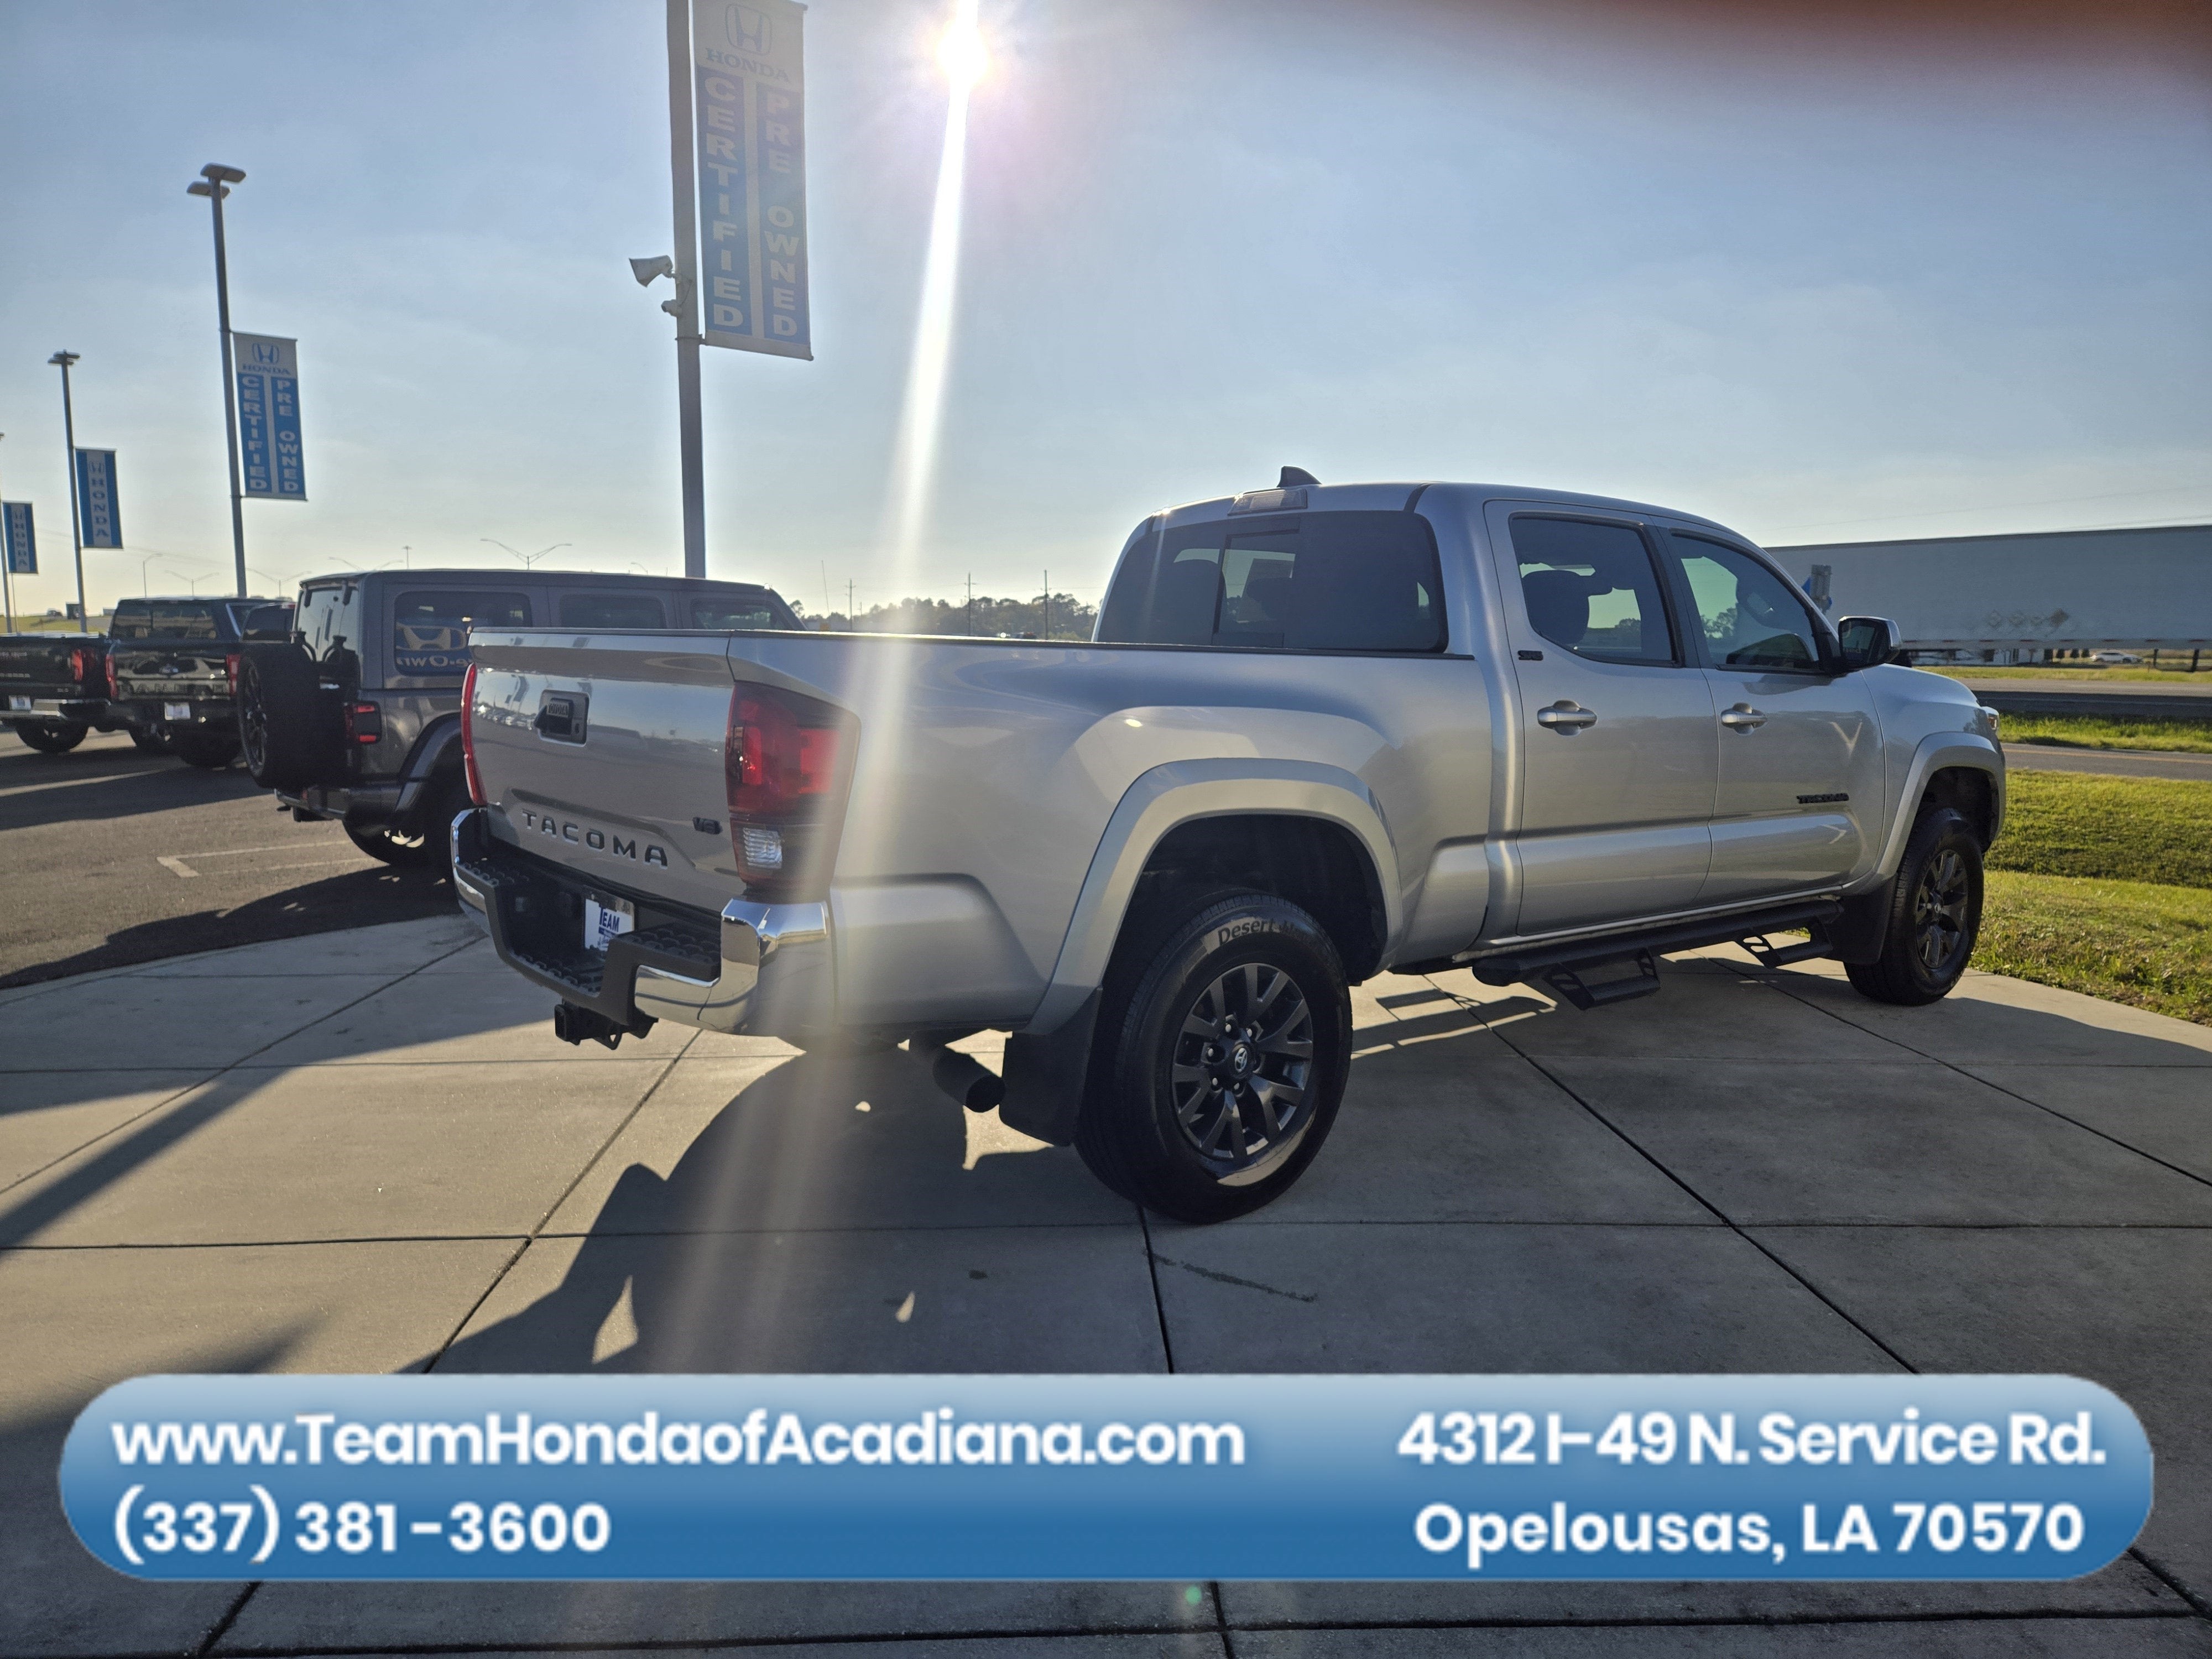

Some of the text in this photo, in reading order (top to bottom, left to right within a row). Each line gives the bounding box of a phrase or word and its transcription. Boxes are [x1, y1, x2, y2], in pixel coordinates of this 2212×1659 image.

[705, 48, 790, 84] HONDA
[704, 75, 744, 327] CERTIFIED
[764, 92, 800, 337] PRE OWNED
[242, 365, 291, 375] HONDA
[242, 375, 267, 491] CERTIFIED
[277, 380, 299, 492] PRE OWNED
[92, 477, 108, 538] HONDA
[547, 703, 568, 716] TOYOTA
[521, 809, 670, 869] TACOMA
[1217, 918, 1274, 946] Desert
